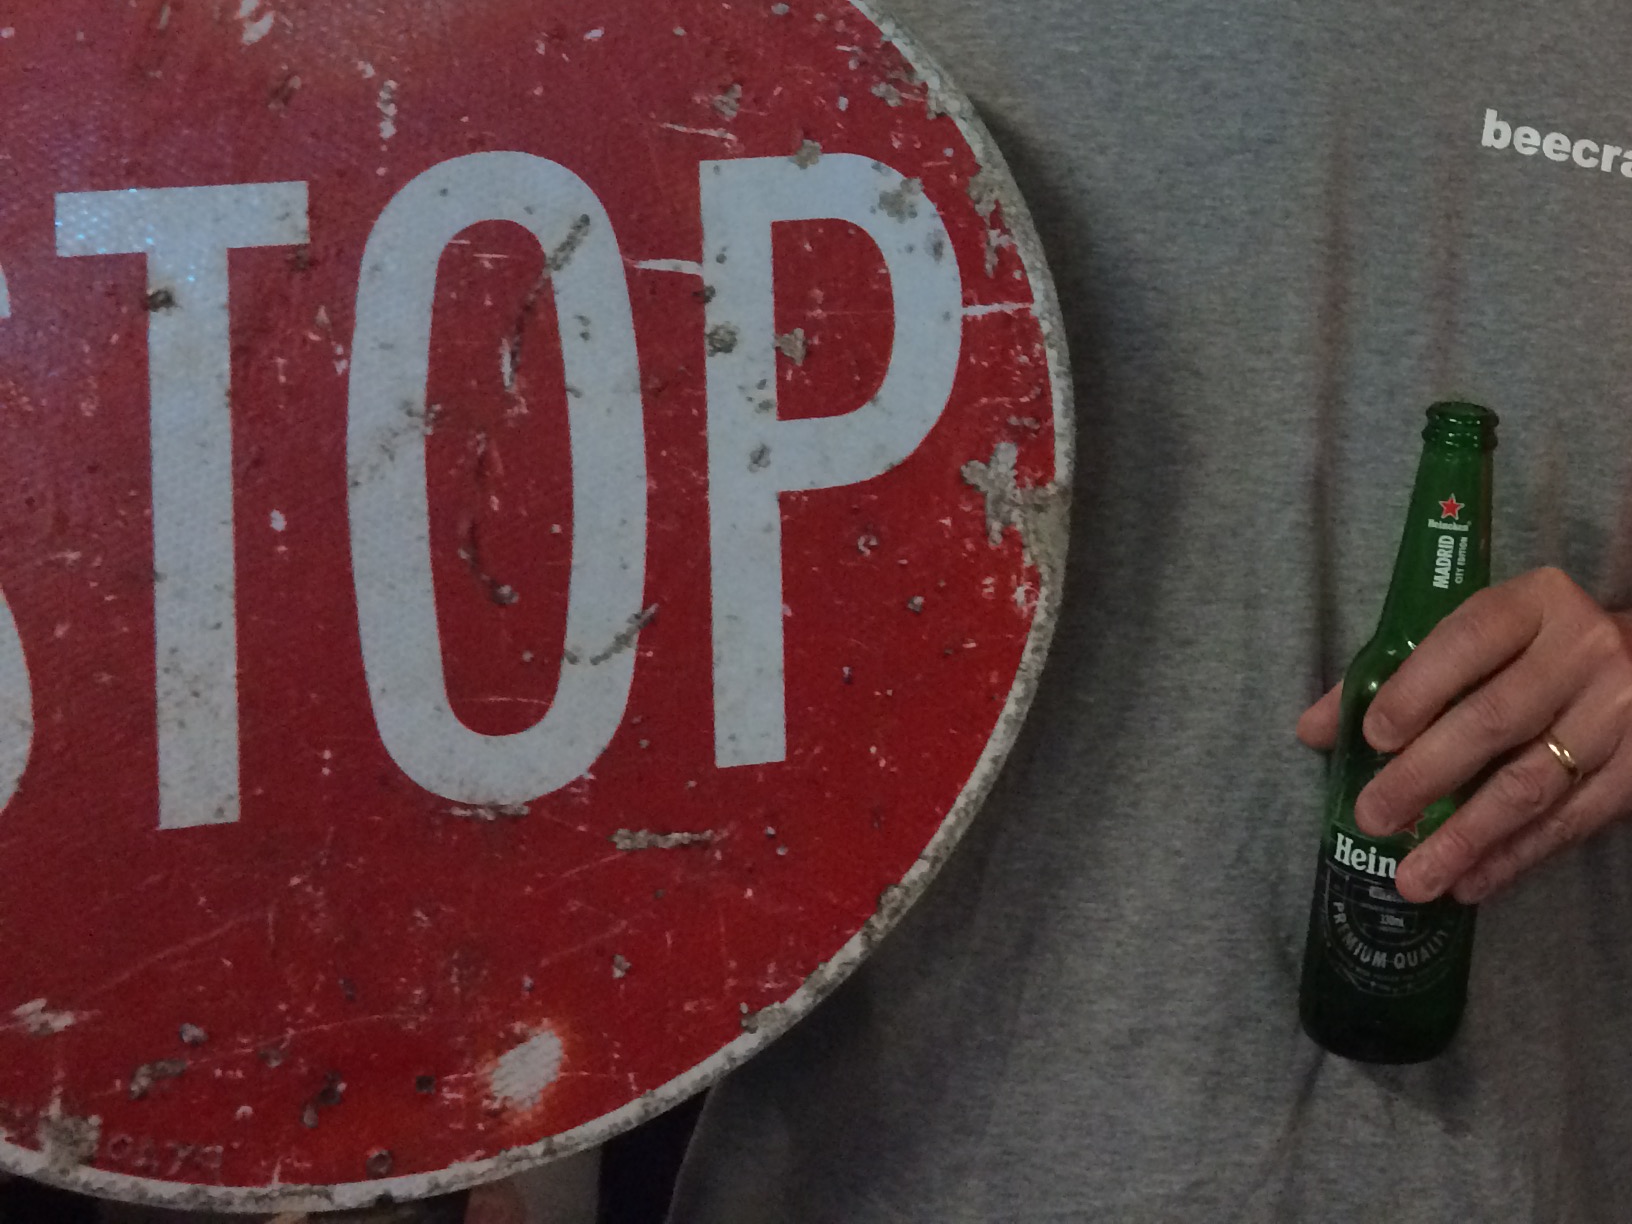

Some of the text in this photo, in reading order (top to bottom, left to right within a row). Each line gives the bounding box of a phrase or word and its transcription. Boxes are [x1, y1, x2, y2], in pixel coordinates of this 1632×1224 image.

[1432, 534, 1455, 590] MADRID
[1454, 536, 1469, 585] CITY EDITION
[1333, 832, 1397, 879] Hein
[1333, 900, 1450, 970] PREMIUM QUALIT
